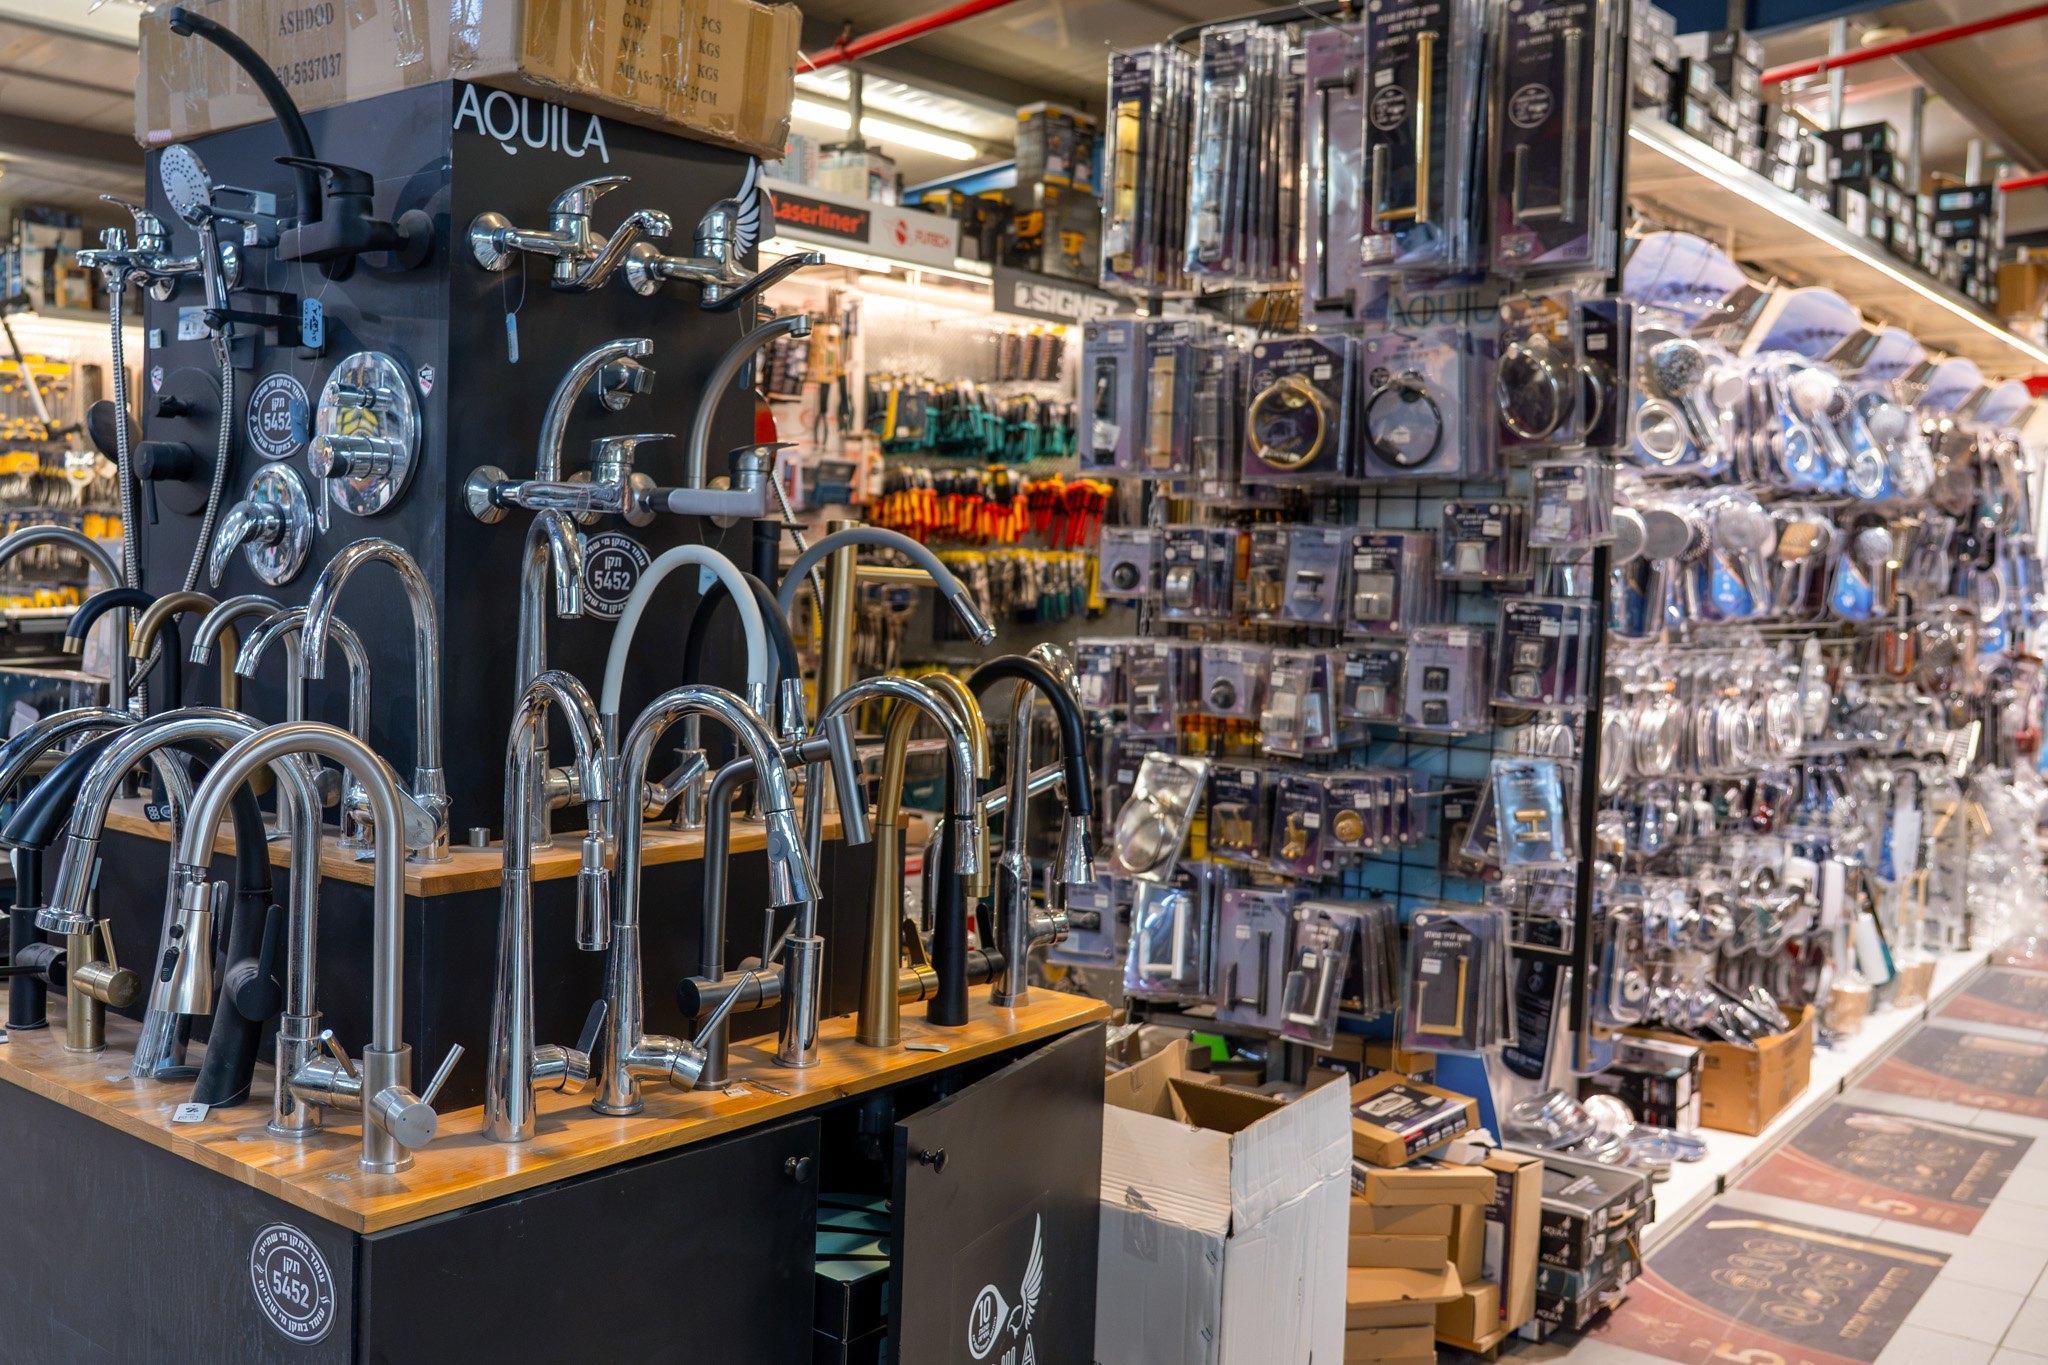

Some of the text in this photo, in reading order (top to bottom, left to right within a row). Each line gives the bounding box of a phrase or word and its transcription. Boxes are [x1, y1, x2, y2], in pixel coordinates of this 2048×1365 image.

[279, 3, 334, 36] ASHDOD
[453, 83, 610, 164] AQUILA
[770, 195, 860, 234] Laserliner
[264, 411, 292, 432] 5452
[604, 556, 622, 570] תקן
[594, 570, 631, 590] 5452
[279, 1232, 288, 1242] מי
[289, 1235, 309, 1255] בתקן
[283, 1256, 300, 1275] תקן
[273, 1270, 310, 1309] 5452
[978, 1295, 991, 1328] 10
[288, 1320, 309, 1333] בתקן
